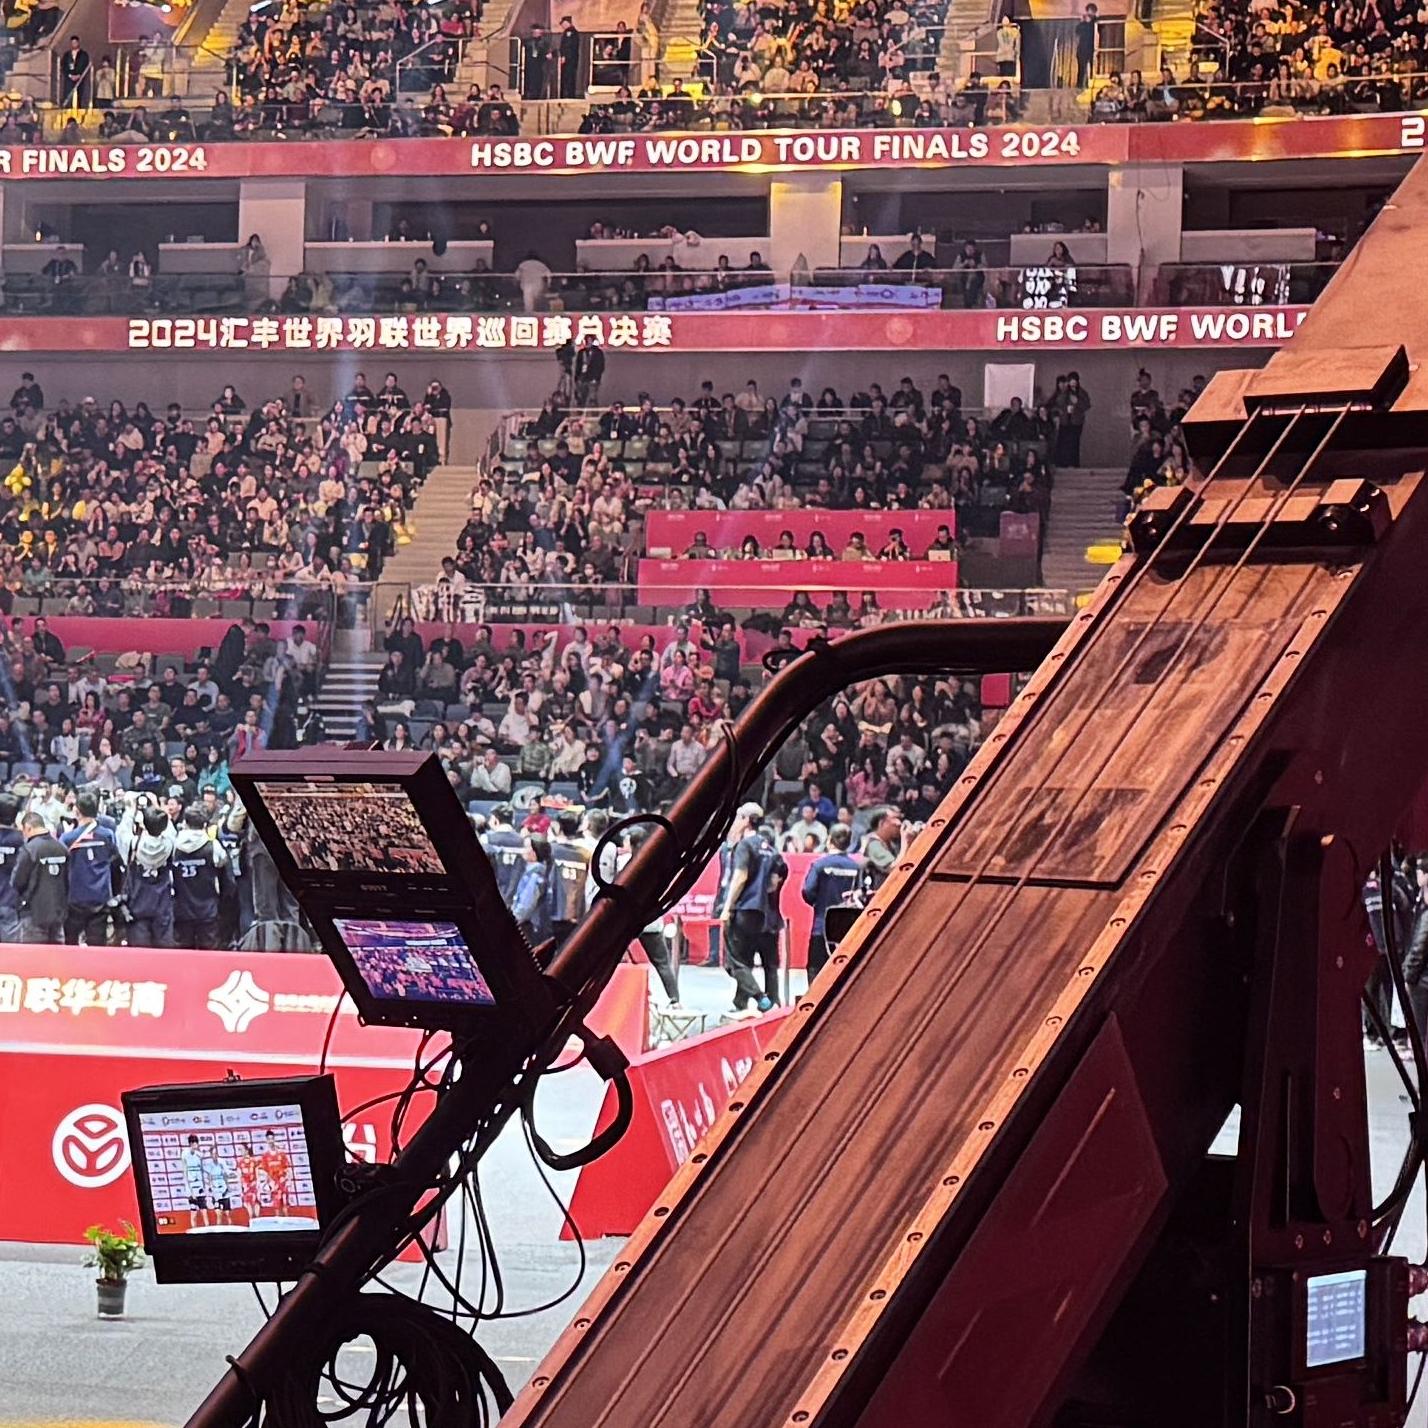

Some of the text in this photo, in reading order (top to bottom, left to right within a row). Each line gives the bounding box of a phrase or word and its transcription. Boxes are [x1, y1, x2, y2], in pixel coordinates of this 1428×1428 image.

[22, 148, 125, 172] FINALS
[136, 147, 207, 172] 2024
[472, 131, 1080, 167] HSBC BWF WORLD TOUR FINALS 2024
[996, 312, 1307, 341] HSBC BWF WORL
